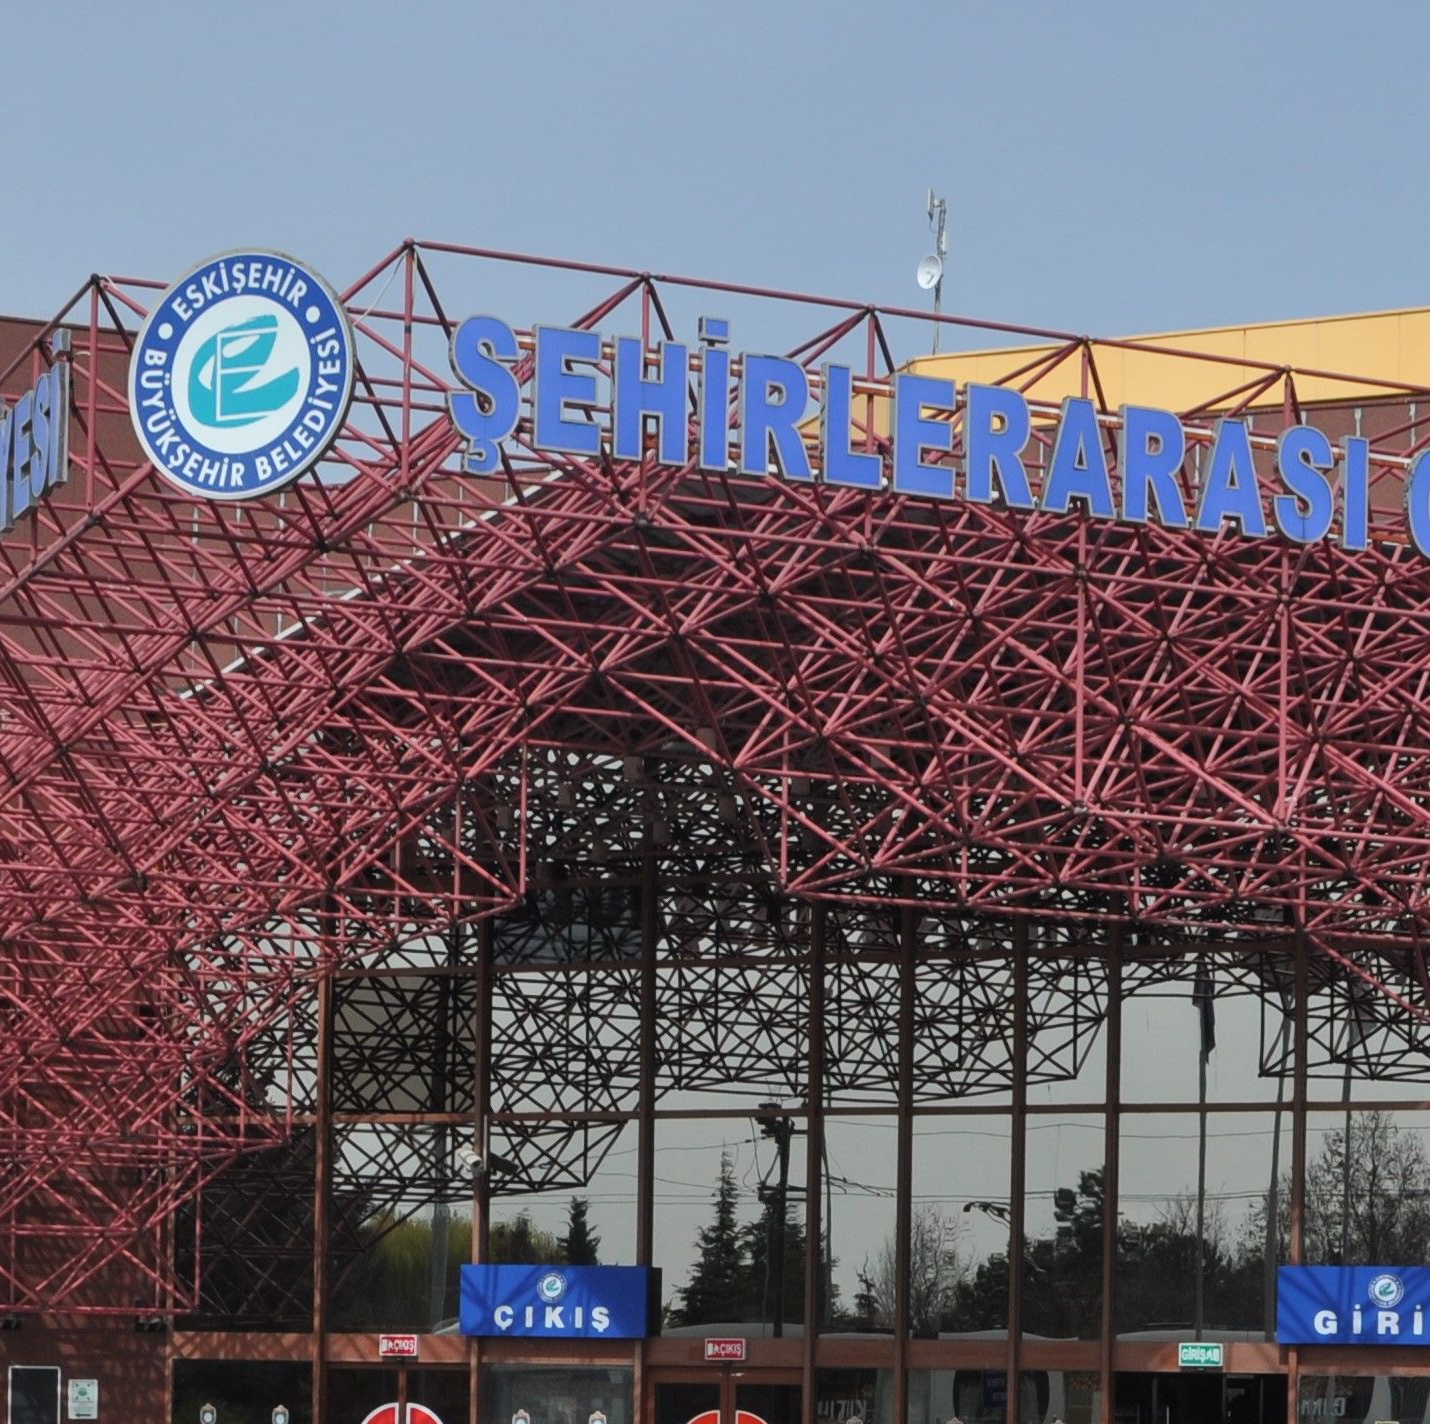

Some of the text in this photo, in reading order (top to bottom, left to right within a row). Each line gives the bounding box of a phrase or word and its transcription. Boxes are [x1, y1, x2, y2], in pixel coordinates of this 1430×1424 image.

[140, 262, 341, 487] ESKİŞEHİR BÜYÜKŞEHİR BELEDİYESİ
[446, 312, 1370, 551] ŞEHİRLERARASI
[493, 1305, 610, 1332] ÇIKIŞ
